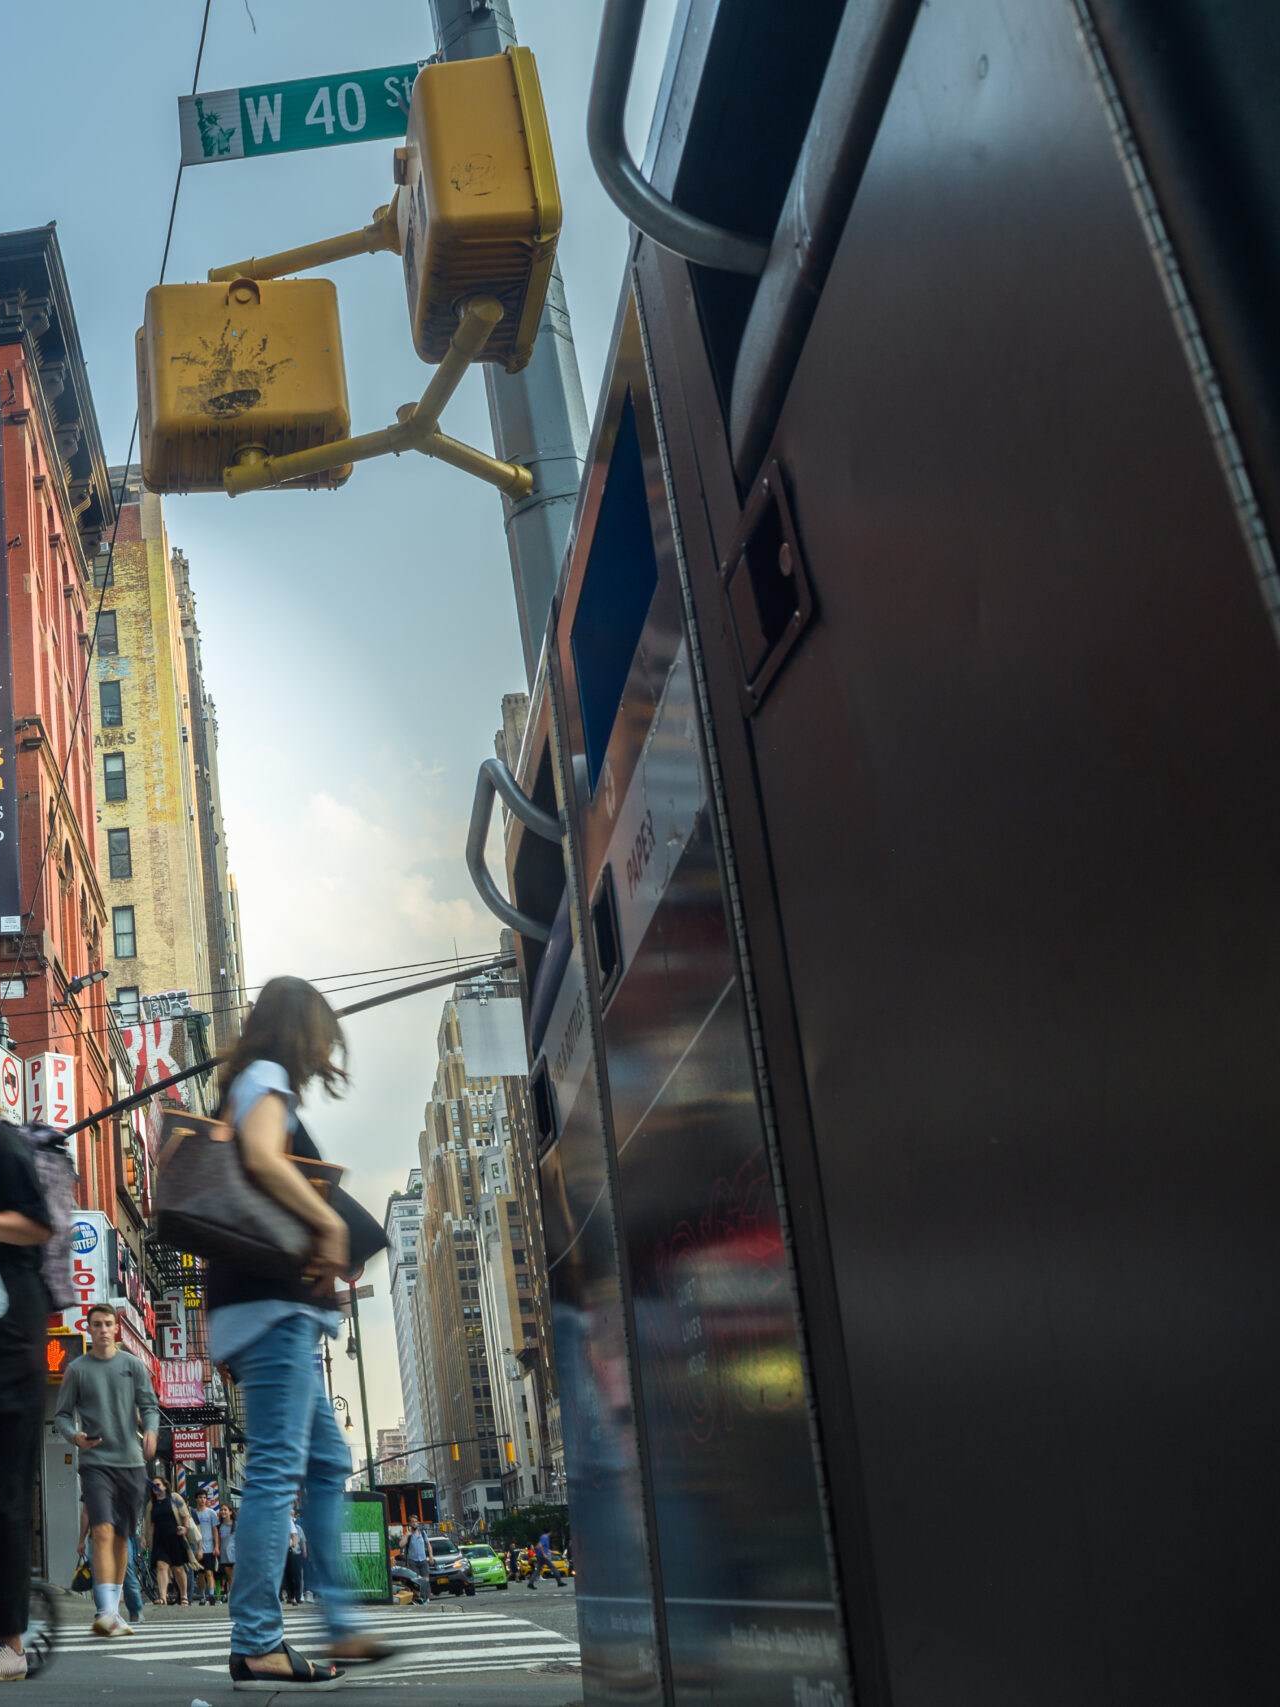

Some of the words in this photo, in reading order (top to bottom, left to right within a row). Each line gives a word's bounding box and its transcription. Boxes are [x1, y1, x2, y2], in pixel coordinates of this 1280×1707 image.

[244, 93, 282, 144] W
[305, 82, 367, 135] 40
[626, 809, 656, 900] PAPER
[160, 1359, 203, 1383] TATTOO
[167, 1383, 196, 1398] PIERCING
[174, 1432, 204, 1440] MONEY
